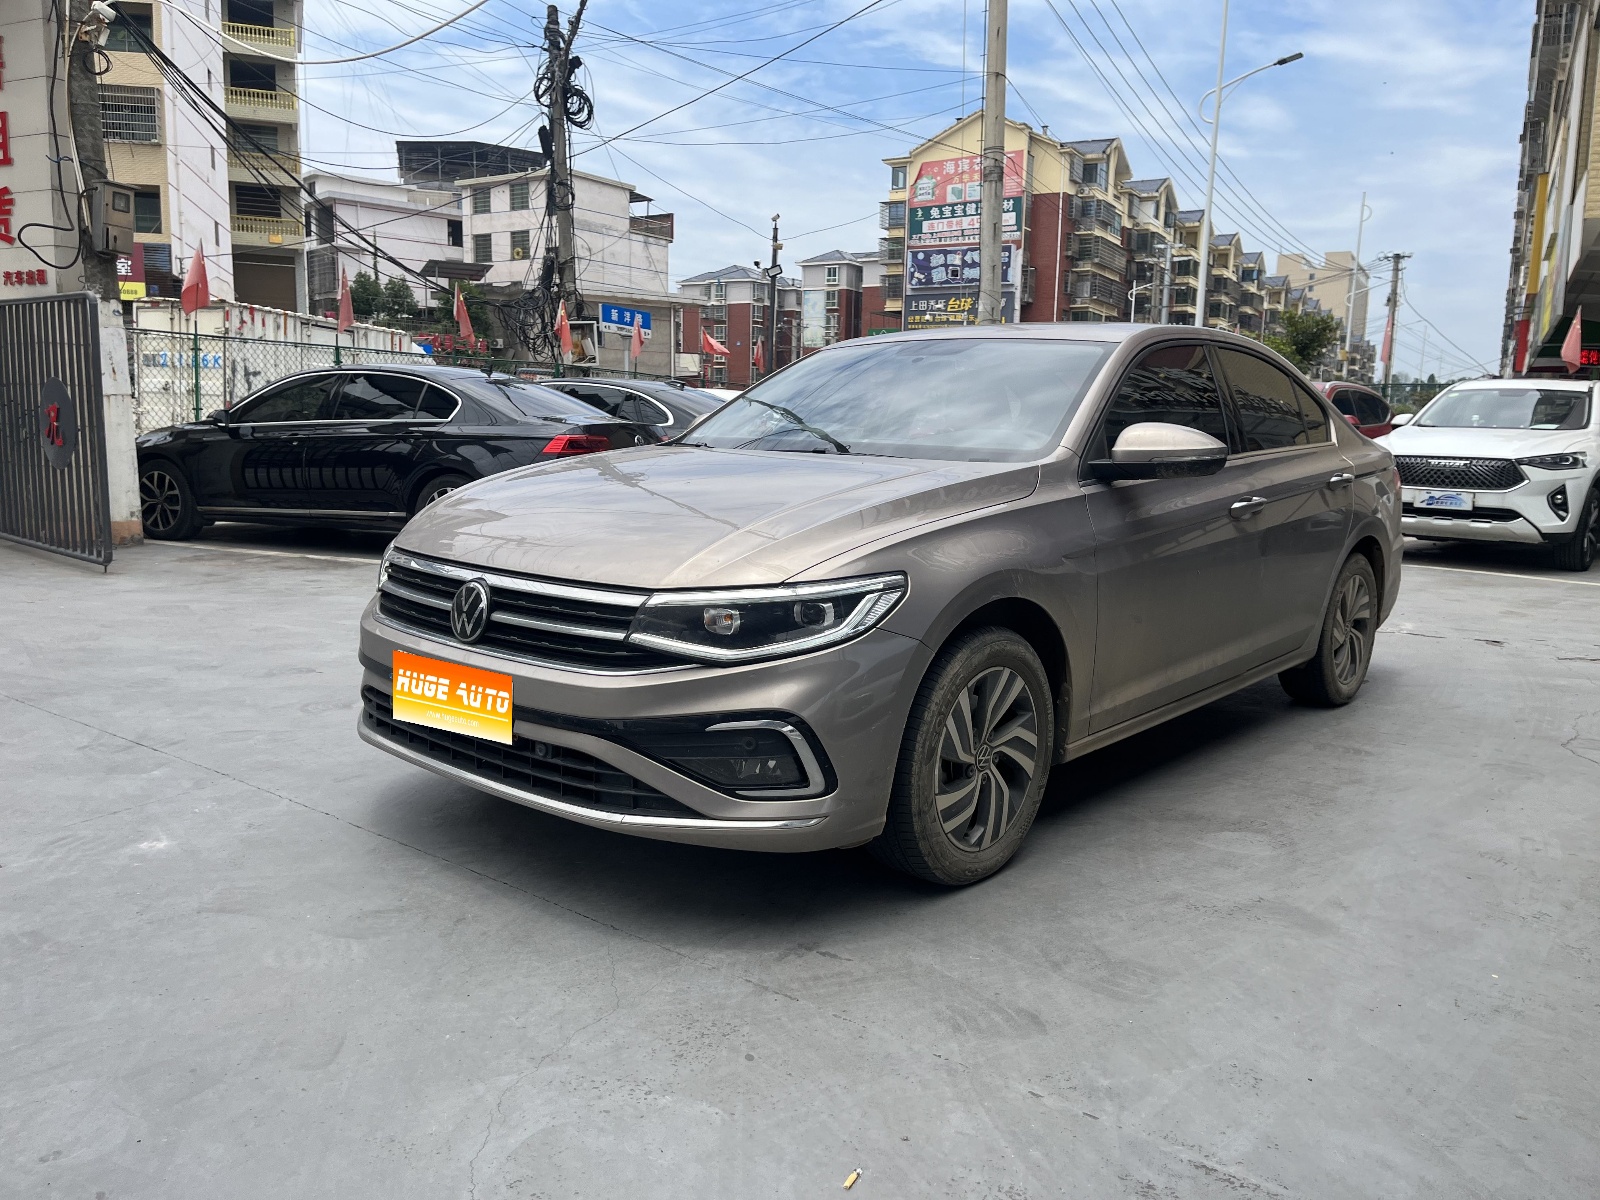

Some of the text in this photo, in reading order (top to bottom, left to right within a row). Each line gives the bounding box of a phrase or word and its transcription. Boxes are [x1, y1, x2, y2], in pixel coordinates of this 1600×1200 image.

[930, 199, 1014, 219] 兔宝宝健材
[116, 258, 132, 276] 室
